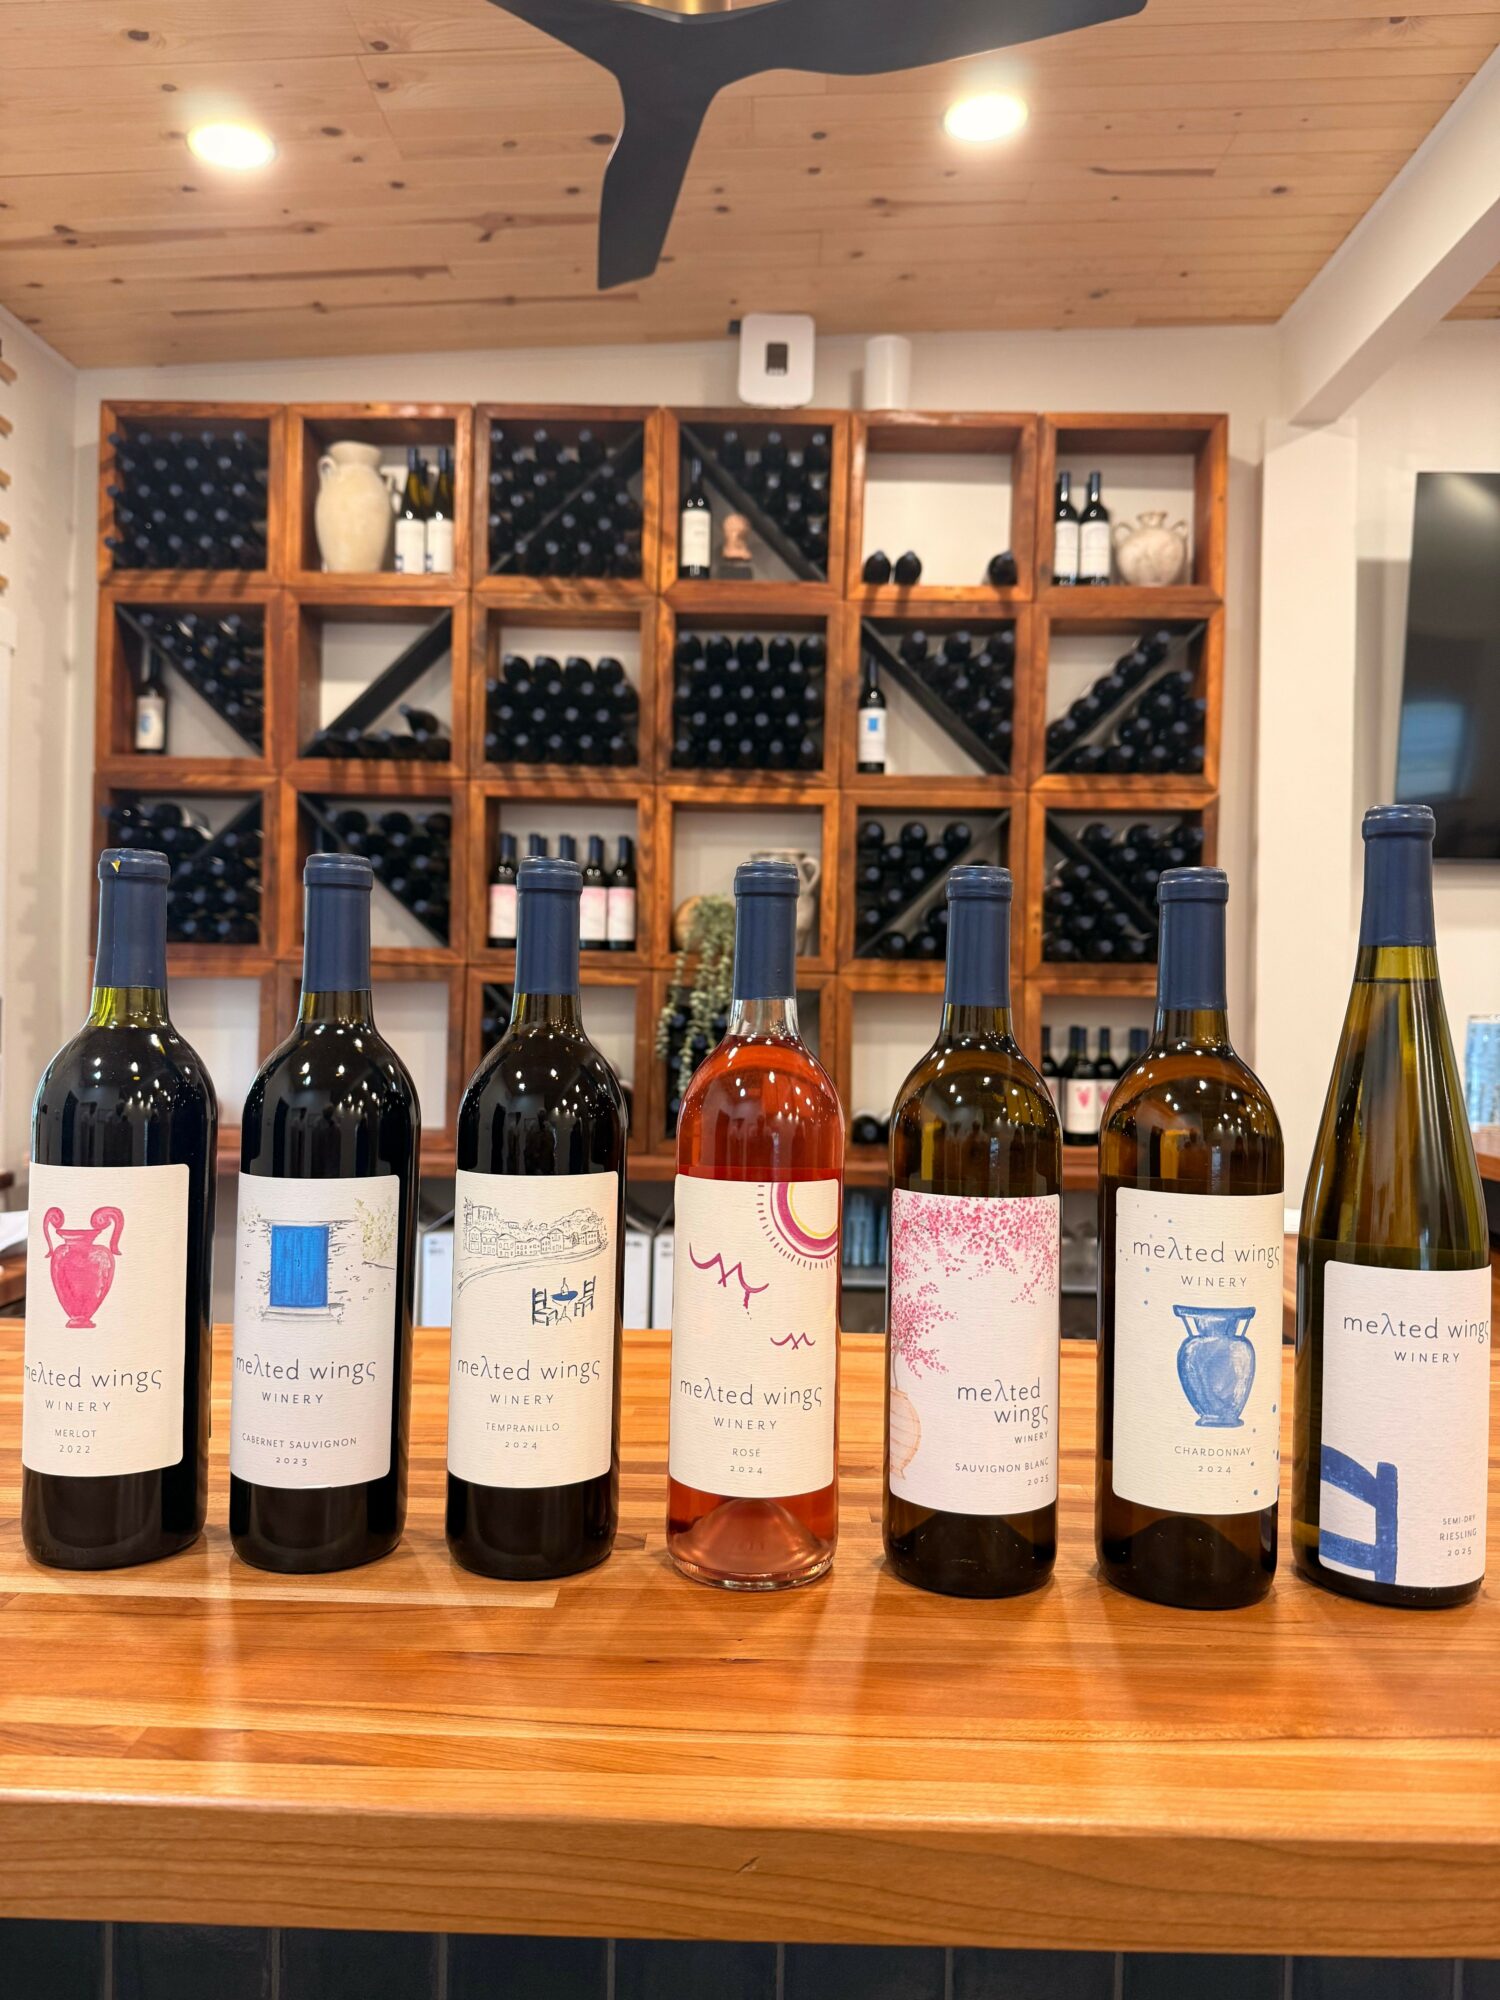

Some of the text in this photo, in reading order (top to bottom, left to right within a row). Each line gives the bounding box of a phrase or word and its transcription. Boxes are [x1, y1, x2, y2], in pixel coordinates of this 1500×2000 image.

[1181, 1275, 1247, 1288] WINERY
[1394, 1351, 1460, 1363] WINERY
[261, 1391, 323, 1404] WINERY
[490, 1394, 554, 1405] WINERY
[45, 1399, 111, 1412] WINERY
[485, 1422, 560, 1433] TEMPRANILLO
[713, 1416, 777, 1430] WINERY
[54, 1429, 97, 1438] MERLOT
[1014, 1430, 1048, 1444] WINERY
[241, 1432, 357, 1449] CABERNET SAUVIGNON
[504, 1441, 537, 1450] 2024
[59, 1444, 91, 1454] 2022
[1174, 1445, 1251, 1457] CHARDONNAY
[275, 1456, 308, 1467] 2023
[955, 1457, 1049, 1473] SAUVIGNON BLANC
[730, 1465, 763, 1474] 2024
[1198, 1465, 1231, 1474] 2024
[1027, 1474, 1049, 1486] 2025
[1439, 1528, 1477, 1541] RIESLING
[1447, 1546, 1472, 1557] 2025
